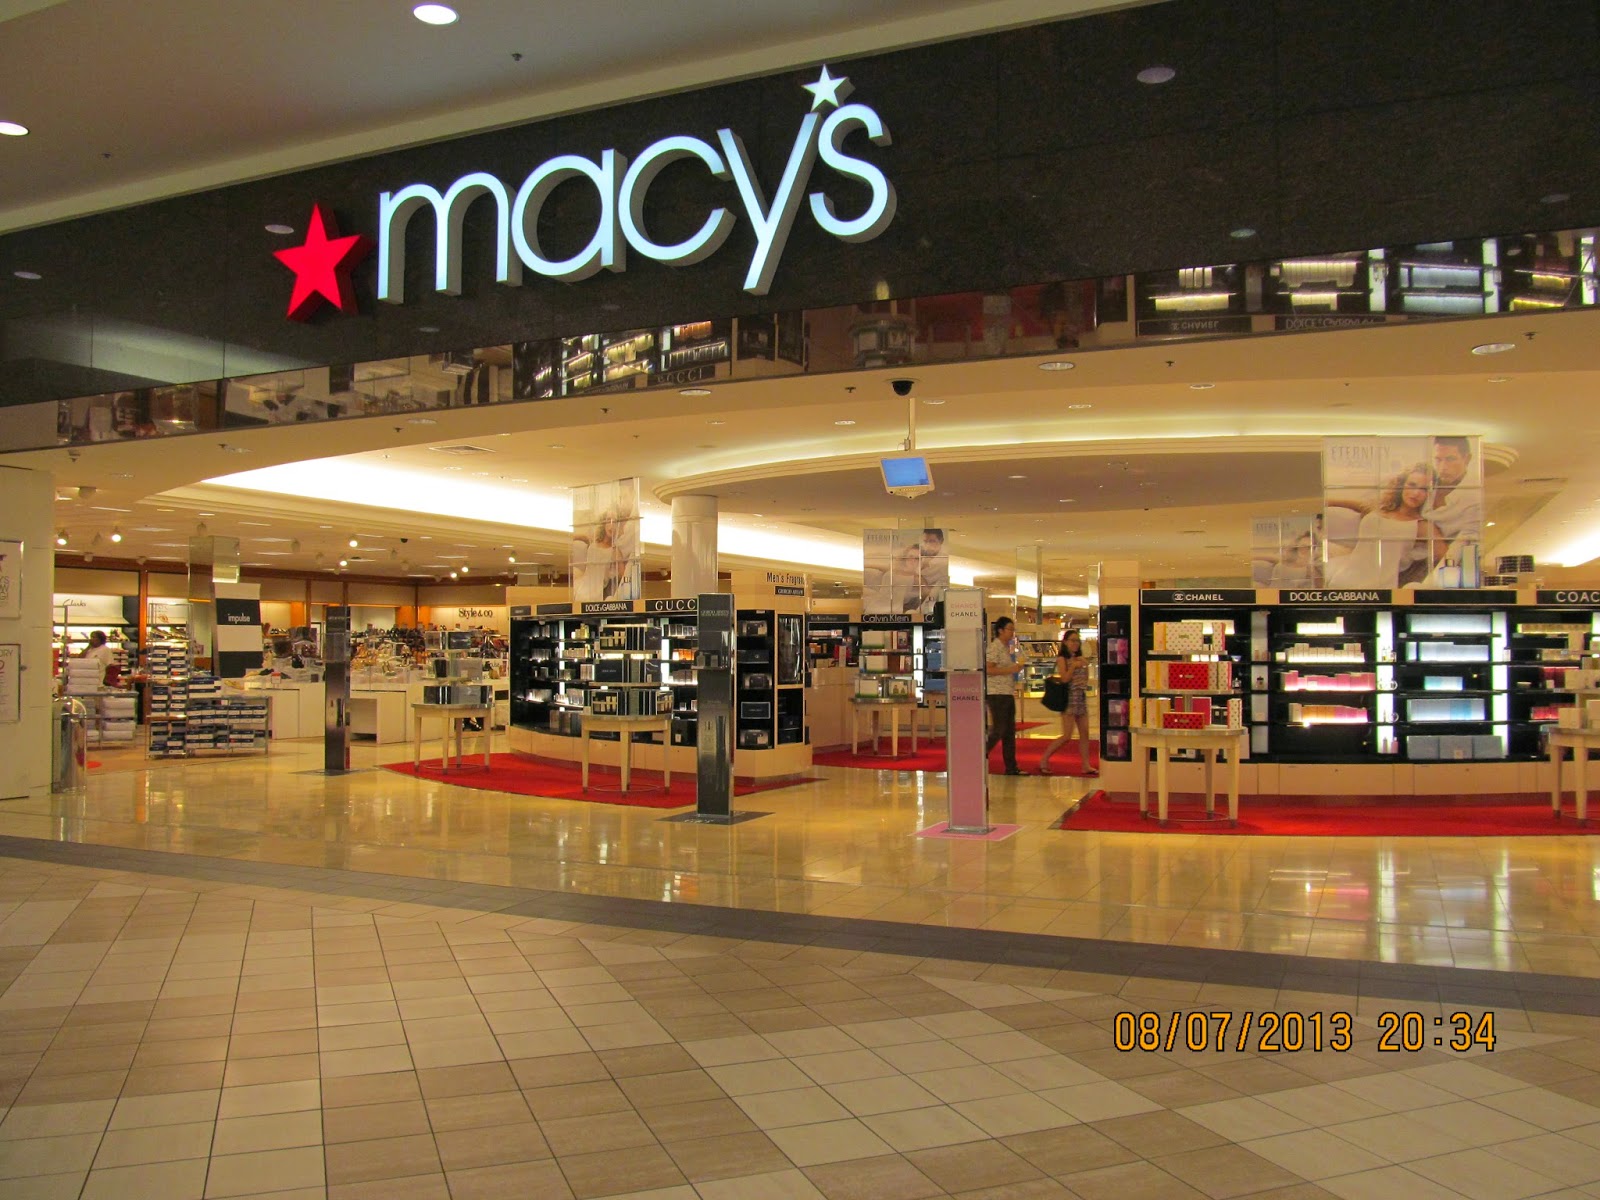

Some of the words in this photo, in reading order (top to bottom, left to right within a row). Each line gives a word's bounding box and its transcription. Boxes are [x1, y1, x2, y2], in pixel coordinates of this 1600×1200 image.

[1185, 593, 1224, 601] CHANEL
[227, 612, 251, 624] impulse
[458, 607, 477, 619] Style
[862, 613, 889, 623] Calvin
[889, 613, 910, 623] Klein
